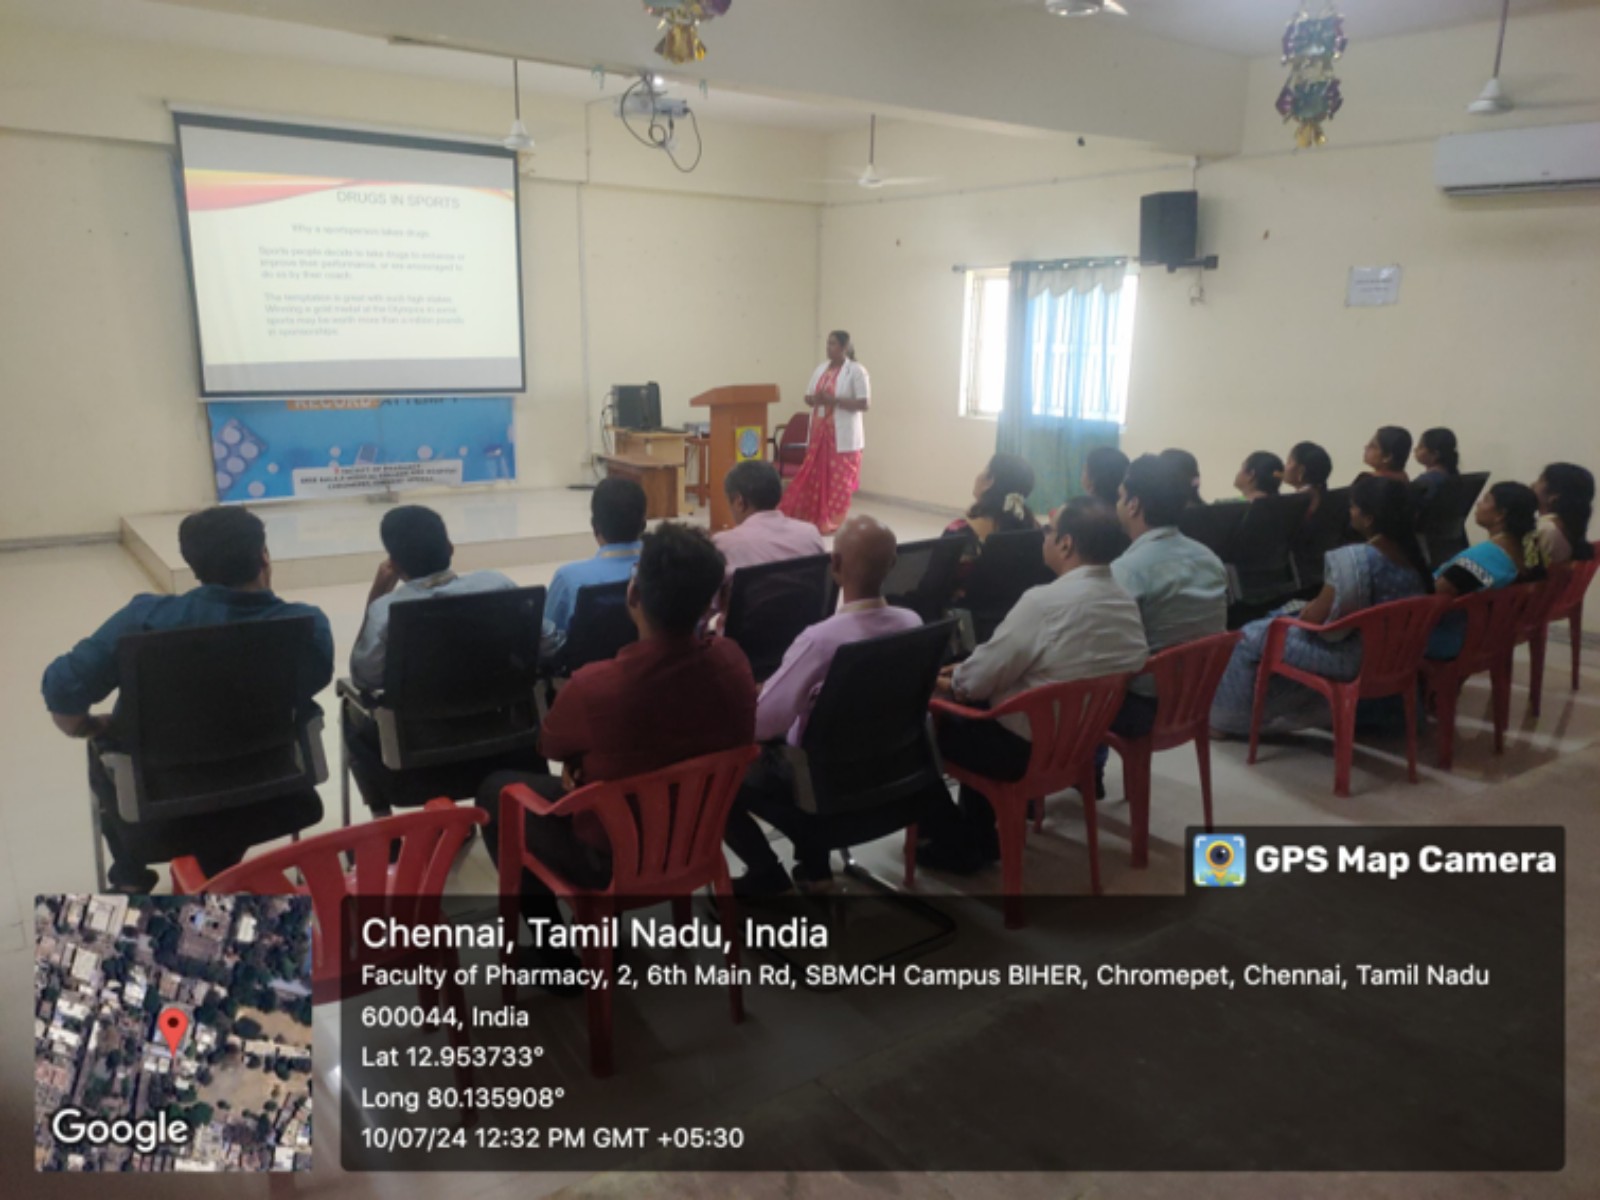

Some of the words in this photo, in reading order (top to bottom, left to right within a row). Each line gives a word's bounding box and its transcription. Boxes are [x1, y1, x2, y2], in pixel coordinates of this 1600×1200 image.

[336, 191, 386, 205] DRUGS
[389, 193, 404, 206] IN
[406, 194, 461, 209] SPORTS
